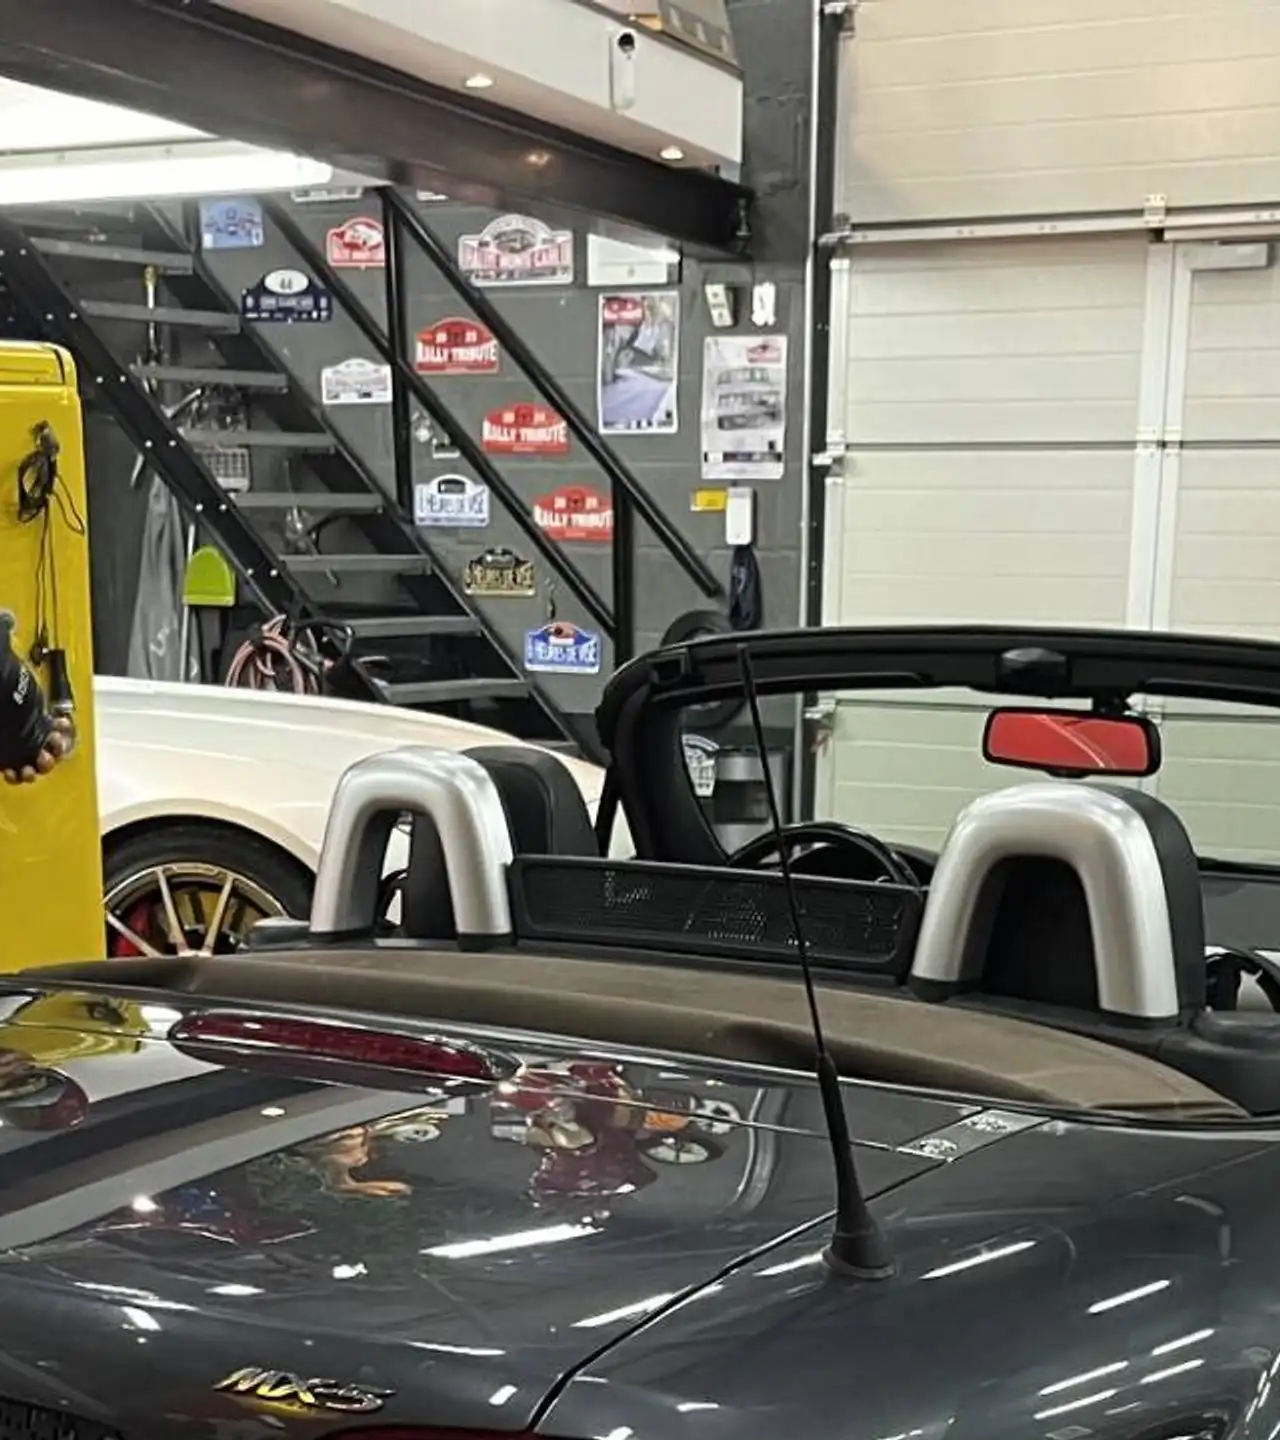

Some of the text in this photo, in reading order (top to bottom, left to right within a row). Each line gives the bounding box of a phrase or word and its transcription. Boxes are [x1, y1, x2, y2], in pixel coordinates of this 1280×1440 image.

[416, 339, 498, 363] RALLY TRIBUTE
[482, 418, 567, 443] RALLY TRIBUTE
